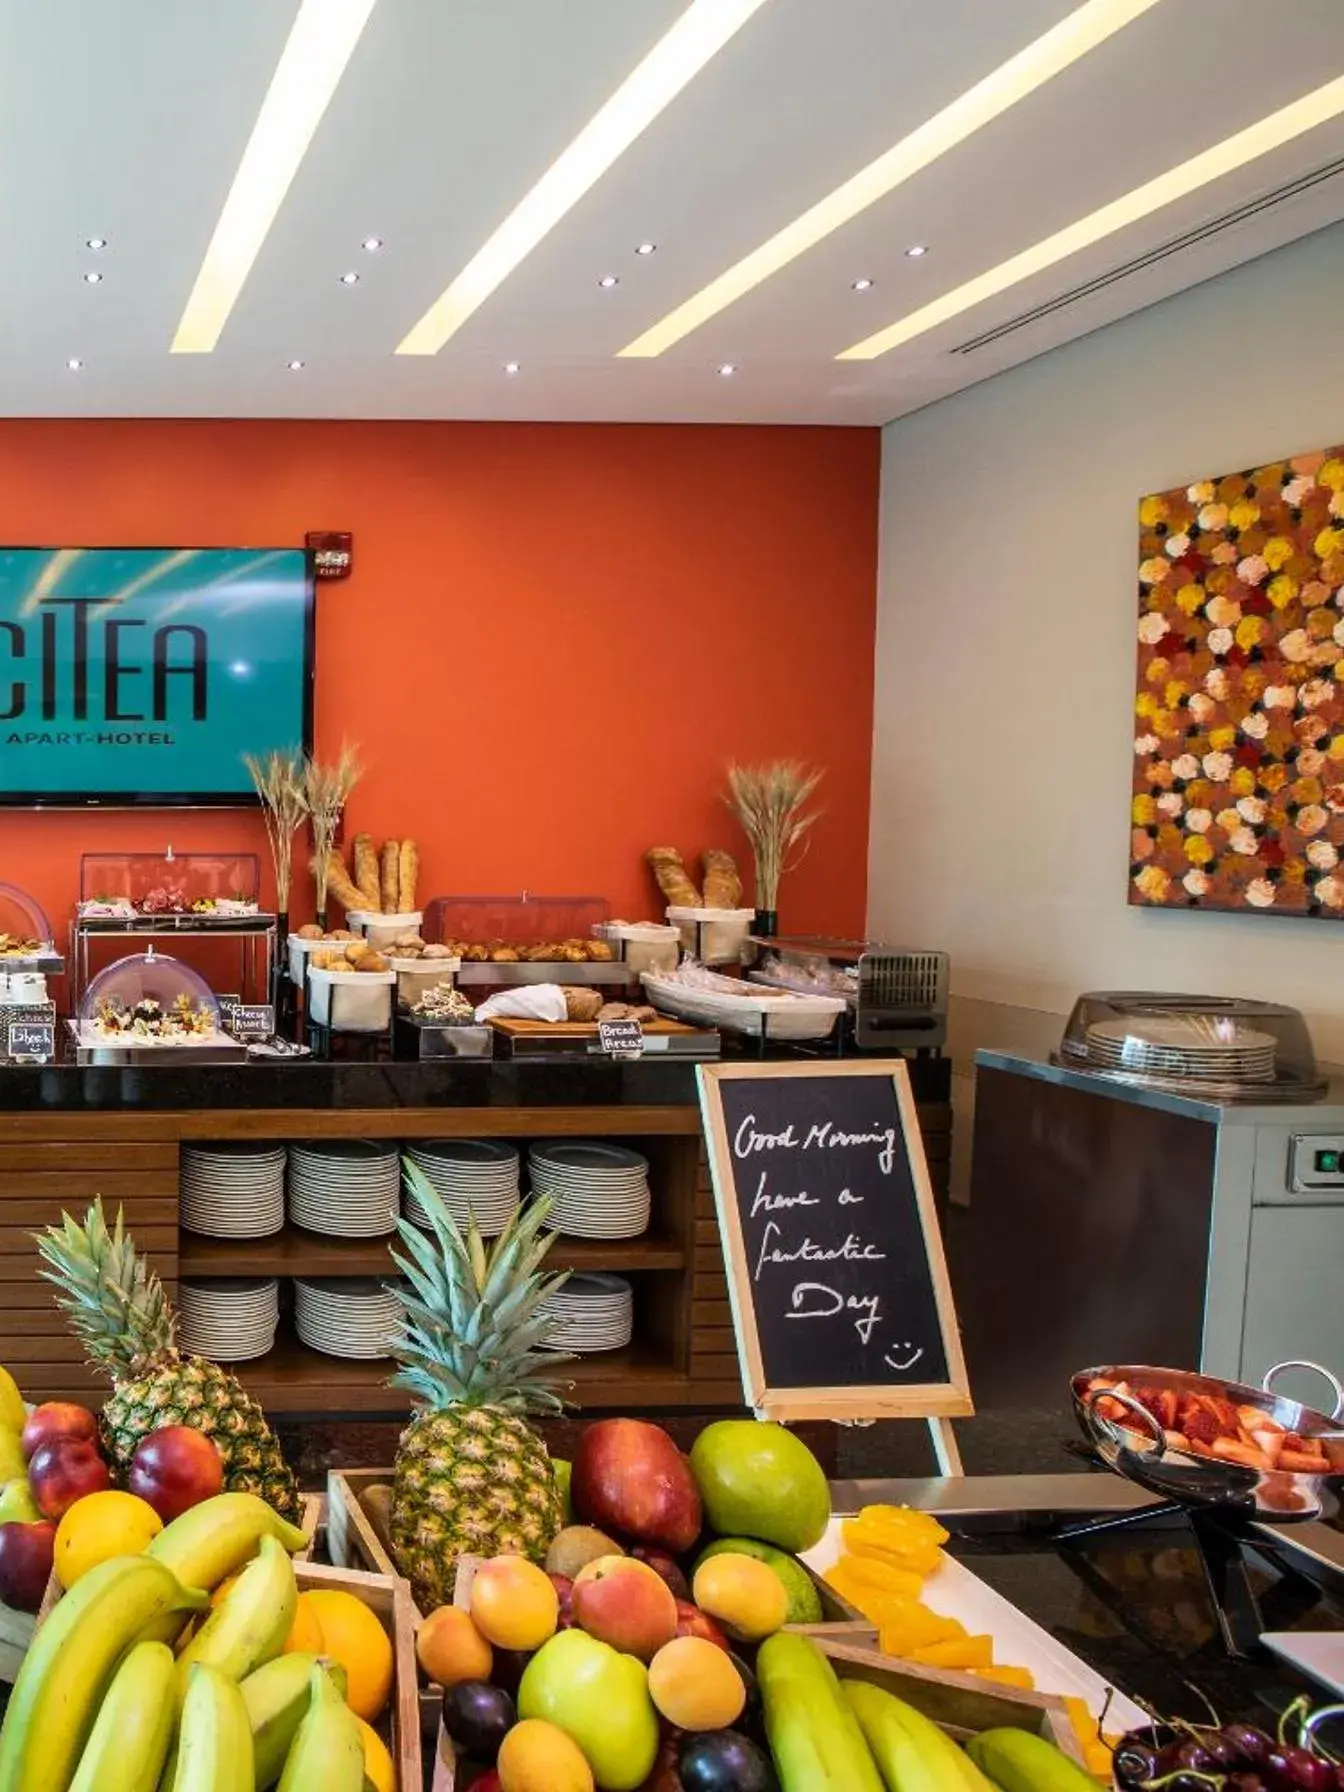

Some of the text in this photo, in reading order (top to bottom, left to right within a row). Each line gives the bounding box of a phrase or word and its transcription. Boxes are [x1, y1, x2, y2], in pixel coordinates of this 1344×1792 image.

[5, 731, 176, 746] APART-HOTEL
[601, 1024, 639, 1037] Bread
[734, 1114, 896, 1175] Good Morning
[750, 1171, 865, 1218] have a
[785, 1282, 884, 1345] Day
